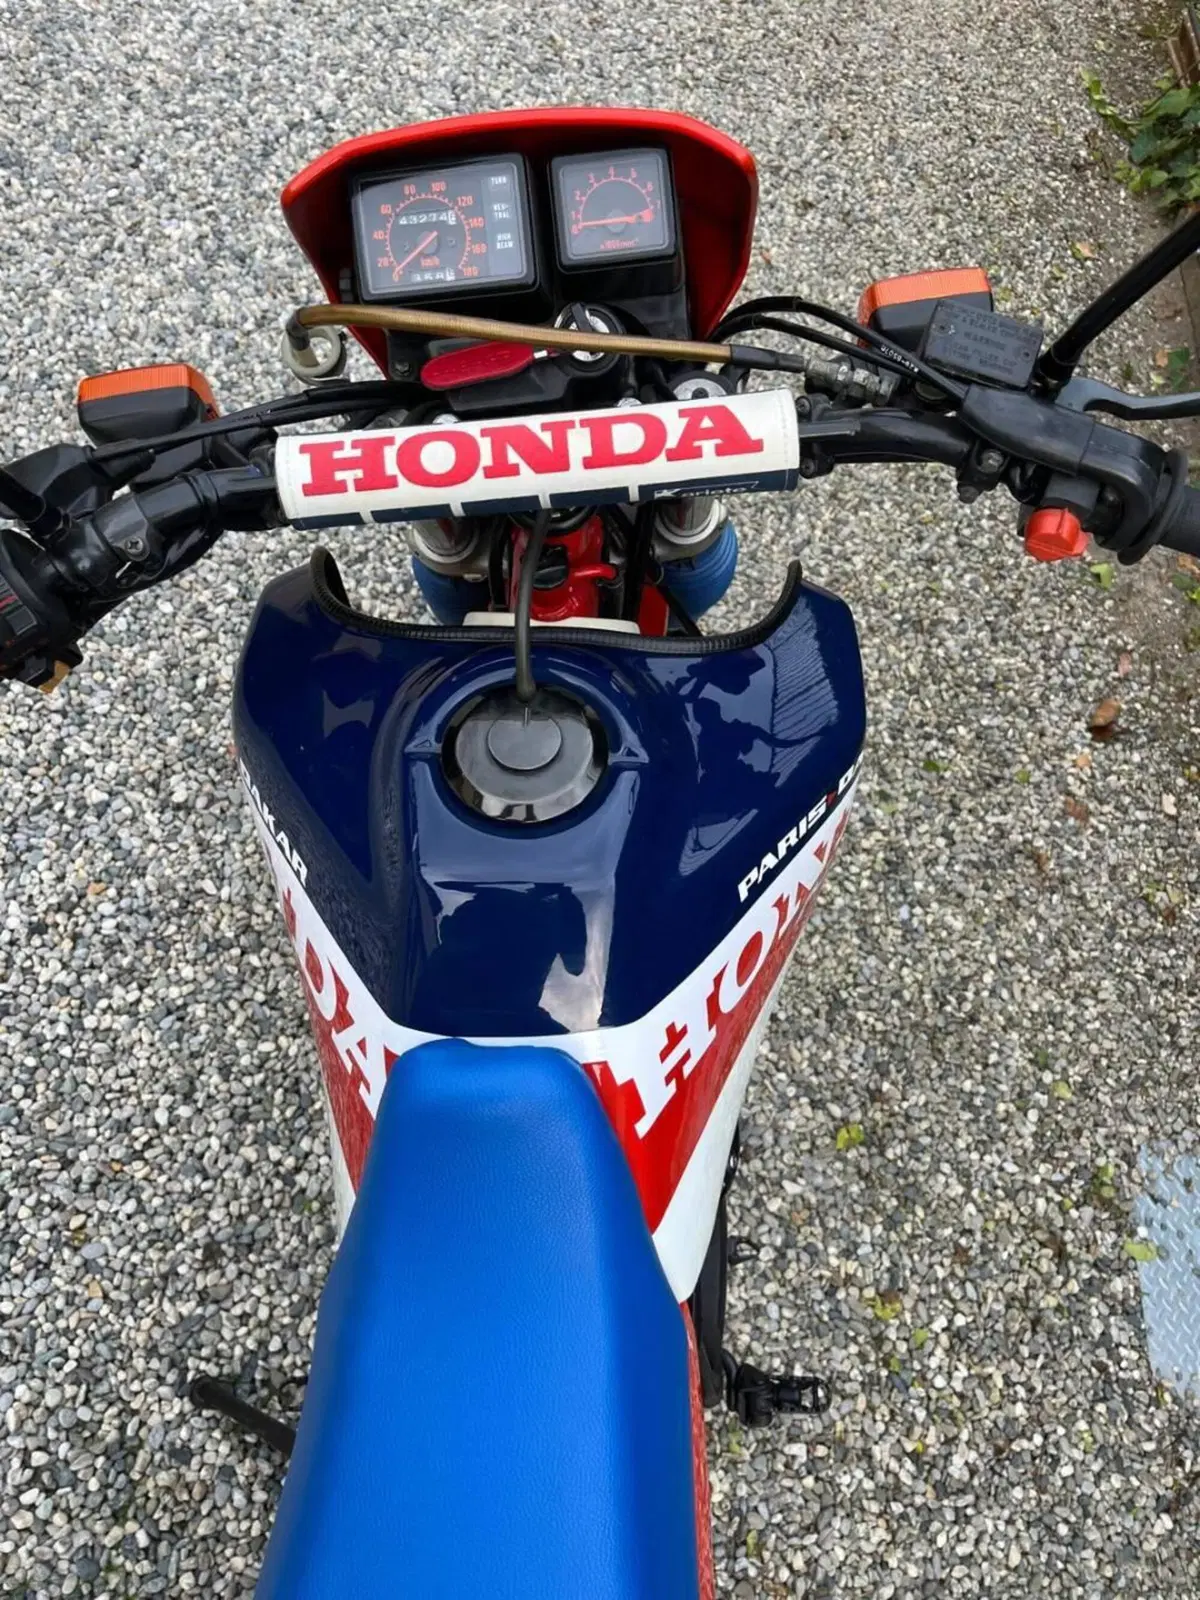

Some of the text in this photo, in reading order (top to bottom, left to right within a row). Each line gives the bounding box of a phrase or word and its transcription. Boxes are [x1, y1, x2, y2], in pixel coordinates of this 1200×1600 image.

[431, 181, 447, 193] 100
[457, 196, 474, 206] 120
[380, 204, 393, 215] 60
[469, 217, 485, 228] 140
[372, 230, 386, 241] 40
[471, 243, 488, 254] 160
[299, 404, 764, 498] HONDA
[737, 793, 828, 903] PARIS
